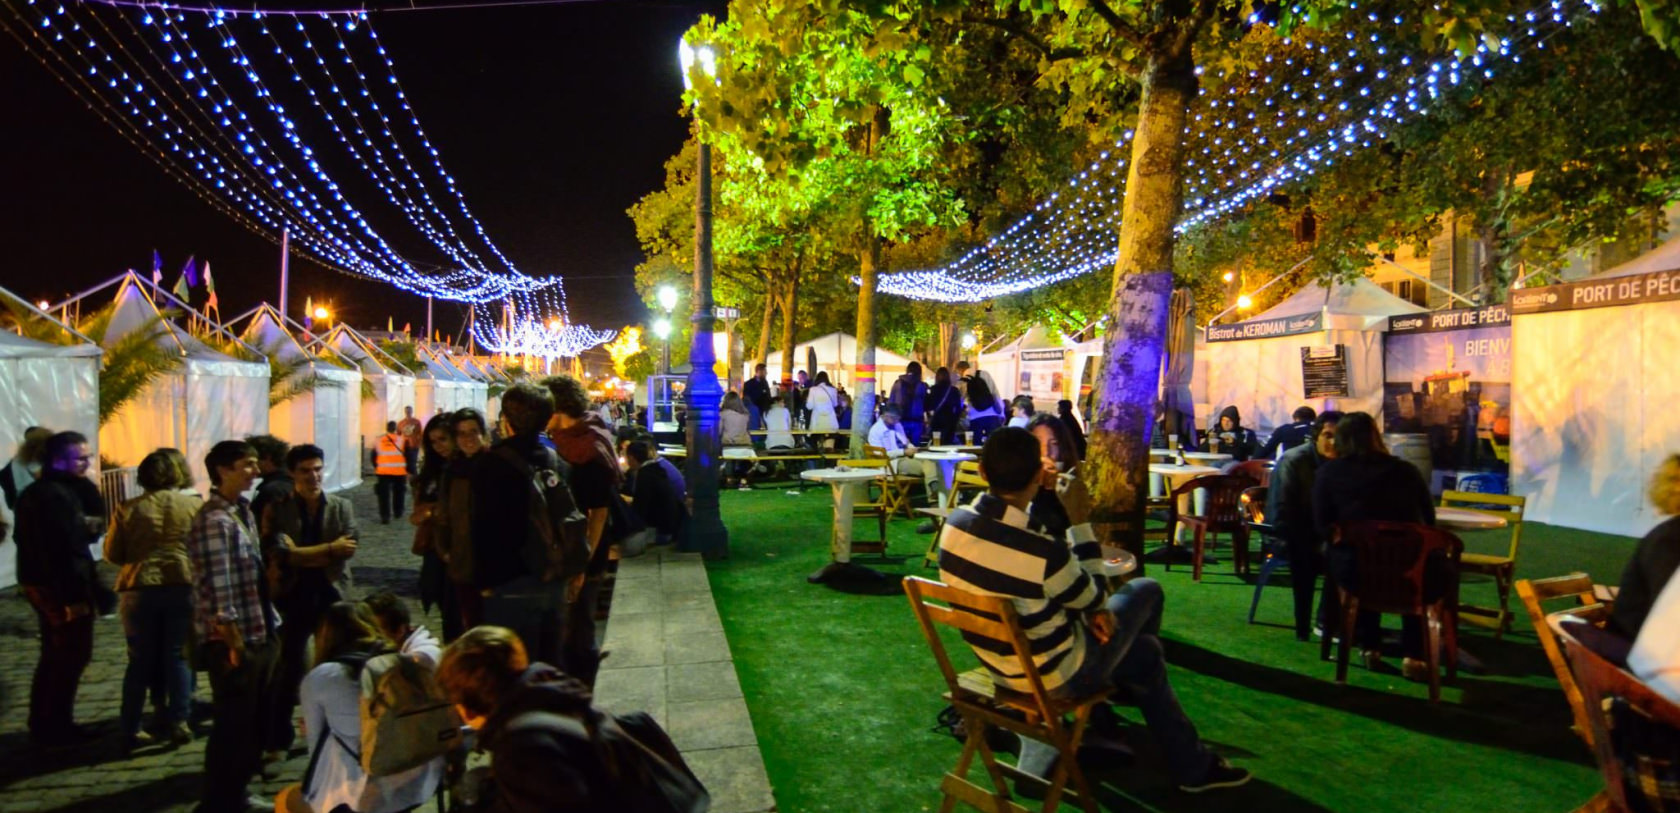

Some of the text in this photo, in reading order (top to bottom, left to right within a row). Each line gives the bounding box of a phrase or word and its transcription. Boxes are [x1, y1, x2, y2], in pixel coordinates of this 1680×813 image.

[1573, 284, 1614, 305] PORT
[1618, 281, 1641, 300] DE
[1432, 313, 1460, 328] PORT
[1462, 311, 1477, 325] DE
[1208, 326, 1235, 340] Bistrot
[1243, 320, 1286, 338] KEROMAN
[1465, 338, 1511, 357] BIENV
